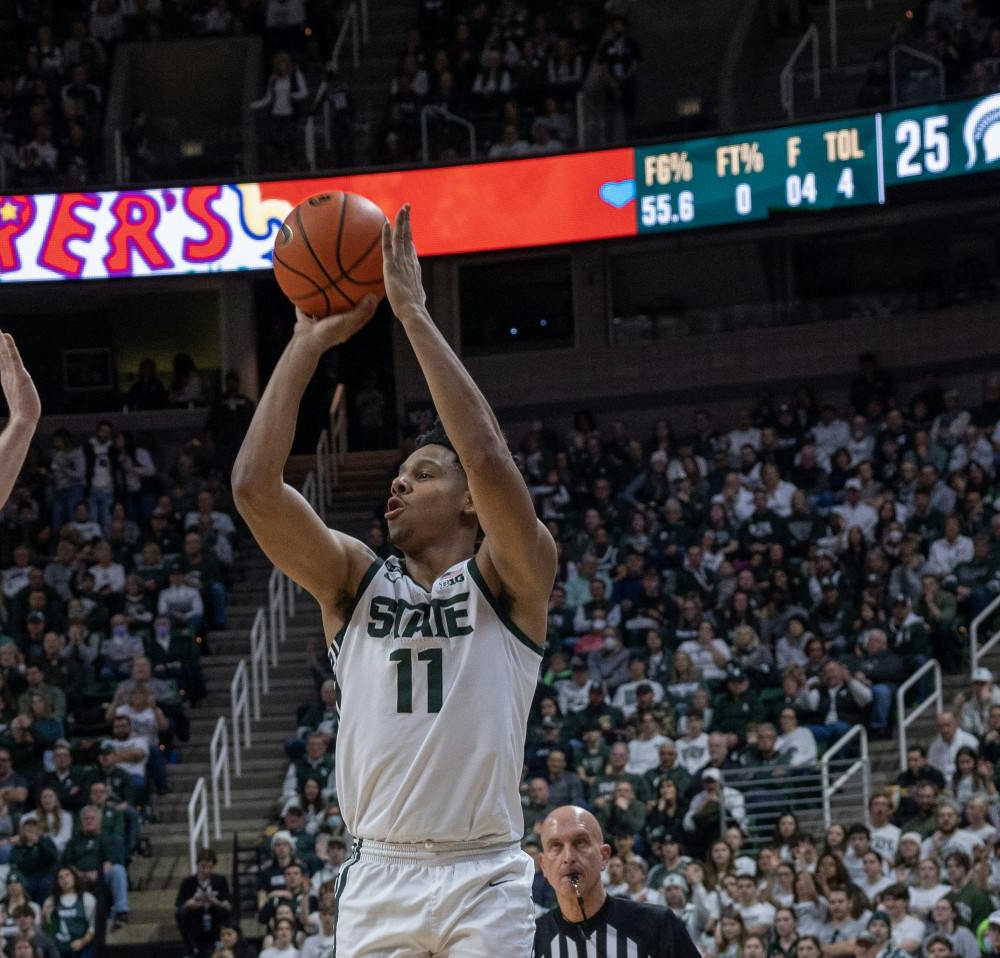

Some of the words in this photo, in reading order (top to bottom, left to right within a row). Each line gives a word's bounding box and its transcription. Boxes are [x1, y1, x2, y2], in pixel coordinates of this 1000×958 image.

[644, 151, 693, 187] FG%
[716, 141, 764, 177] FT%
[786, 136, 801, 168] F
[823, 128, 865, 162] TOL
[895, 114, 950, 178] 25
[641, 190, 695, 227] 55.6
[734, 182, 752, 215] 0
[785, 172, 818, 207] 04
[836, 167, 855, 198] 4
[367, 592, 475, 638] STATE
[389, 648, 443, 714] 11
